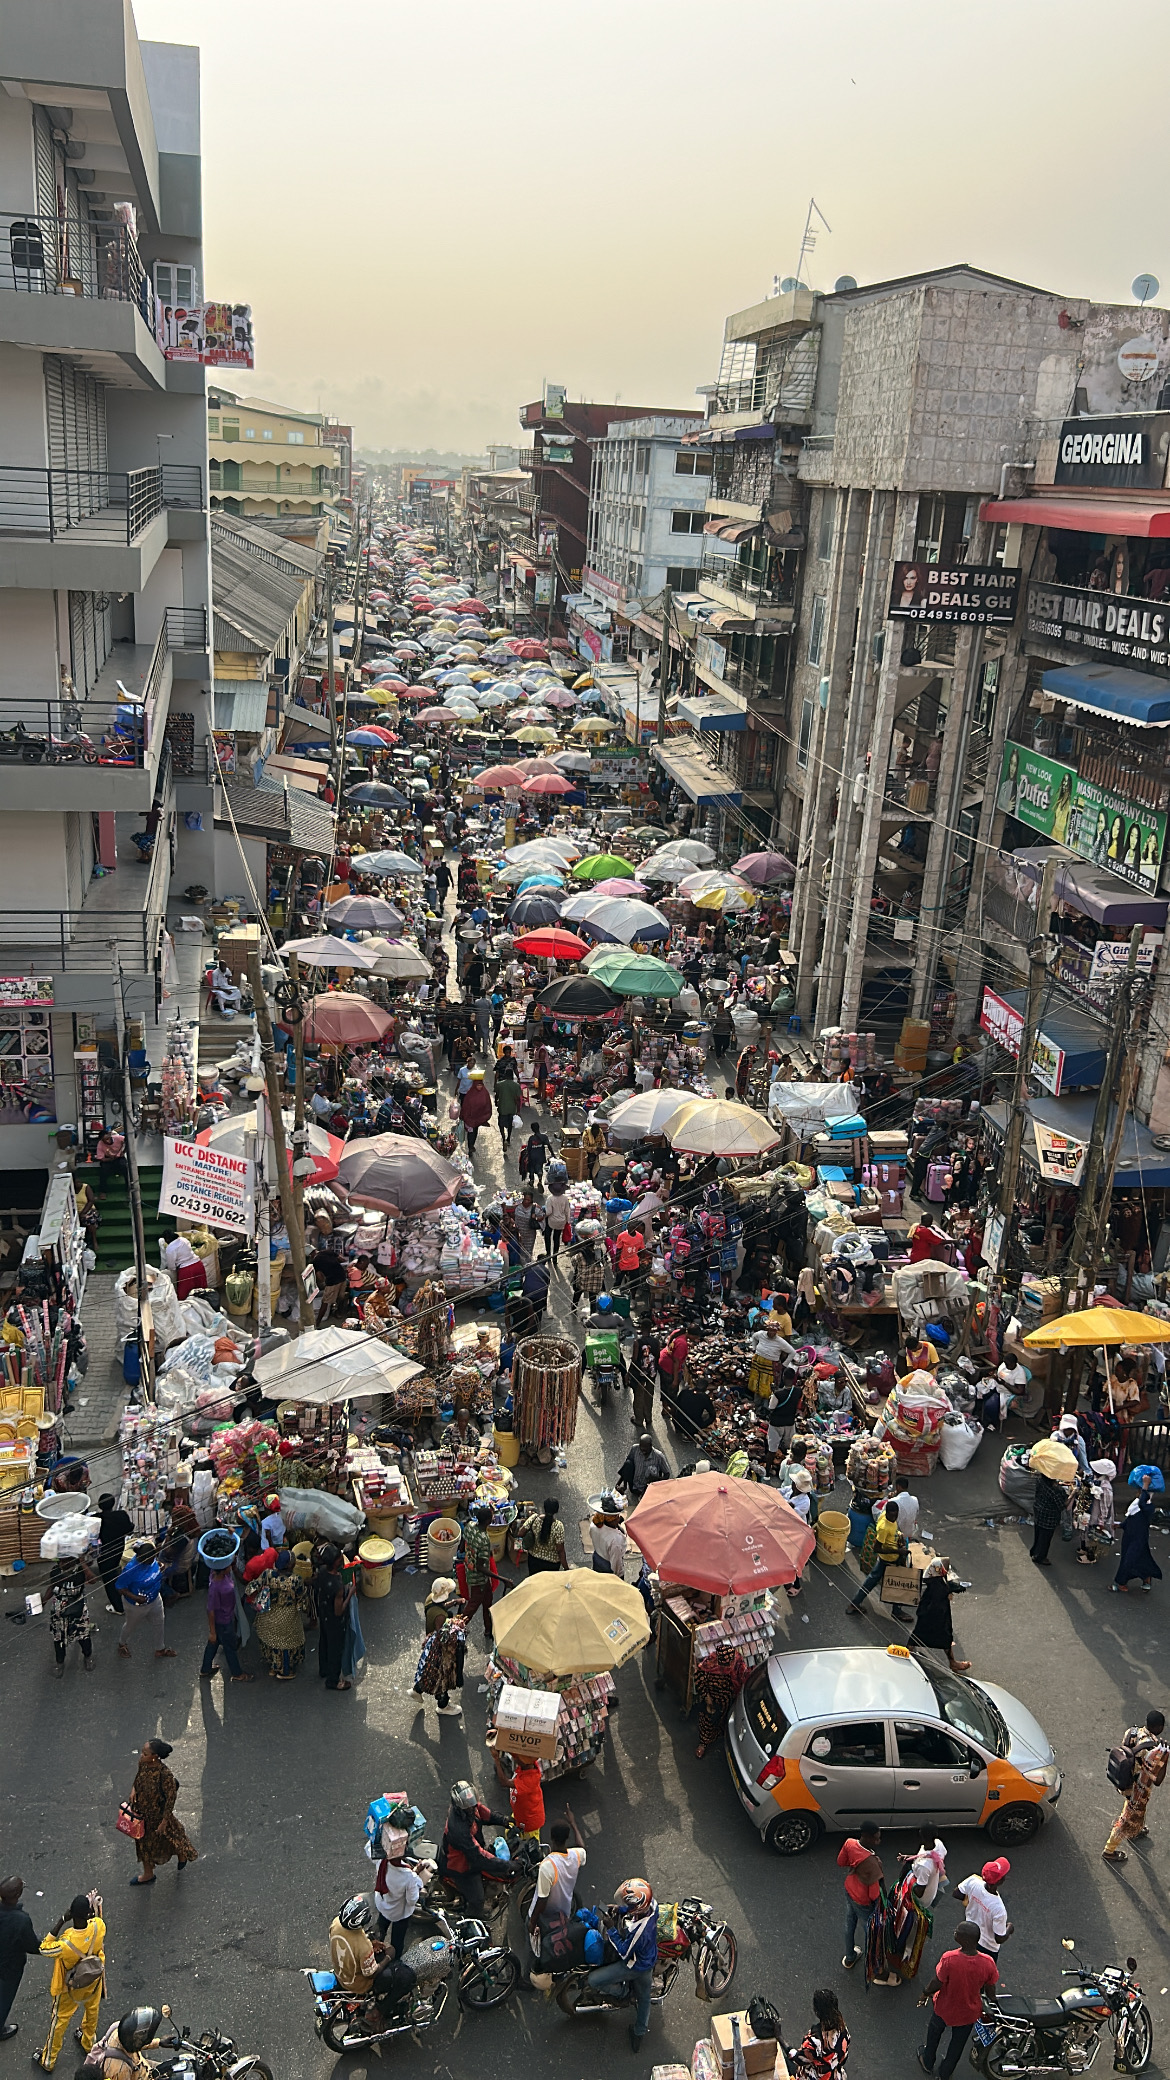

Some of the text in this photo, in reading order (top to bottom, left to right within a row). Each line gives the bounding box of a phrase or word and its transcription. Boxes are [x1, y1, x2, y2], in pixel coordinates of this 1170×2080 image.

[1061, 433, 1143, 465] GEORGINA
[928, 570, 1016, 588] BEST HAIR
[929, 591, 1011, 609] DEALS GH
[910, 609, 993, 622] 0249516095
[1027, 590, 1062, 620] BEST
[1062, 596, 1101, 630] HAIR
[1105, 605, 1163, 644] DEALS
[1111, 640, 1129, 656] WIGS
[1131, 646, 1147, 660] AND
[1151, 650, 1166, 665] WIG
[1026, 763, 1052, 782] NEW LOOK
[1076, 781, 1159, 831] MASITO COMPANY LTD.
[1127, 869, 1138, 881] 171
[174, 1142, 248, 1175] UCC DISTANCE
[175, 1163, 206, 1177] ENTRANCE
[176, 1181, 244, 1208] DISTANCE REGULAR
[203, 1183, 218, 1192] YEARS
[170, 1194, 201, 1212] 0243
[202, 1203, 224, 1218] 910
[225, 1210, 246, 1226] 622
[592, 1348, 607, 1358] Bolt
[594, 1355, 612, 1364] Food
[753, 1565, 769, 1575] cash
[891, 1648, 908, 1657] TAXI
[509, 1733, 542, 1746] SIVOP
